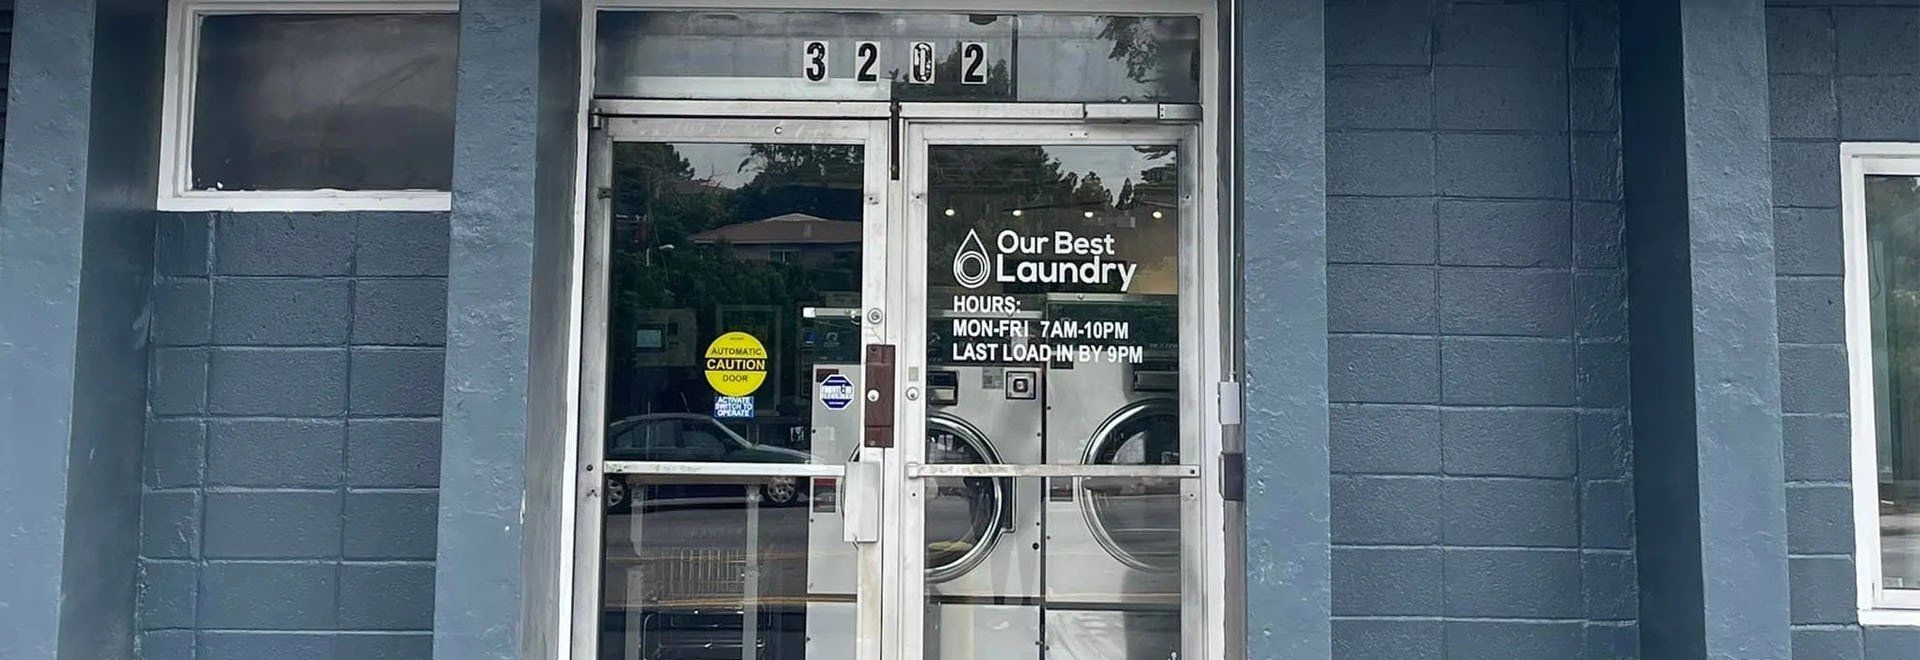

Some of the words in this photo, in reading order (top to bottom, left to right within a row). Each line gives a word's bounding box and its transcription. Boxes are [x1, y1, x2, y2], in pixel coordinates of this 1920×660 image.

[997, 230, 1049, 254] Our
[1054, 231, 1115, 255] Best
[996, 254, 1137, 292] Laundry
[953, 295, 1021, 313] HOURS:
[953, 319, 1029, 337] MON-FRI
[1040, 321, 1129, 339] 7AM-10PM
[711, 347, 762, 356] AUTOMATIC
[952, 343, 998, 361] LAST
[1003, 344, 1050, 362] LOAD
[1056, 345, 1074, 362] IN
[1078, 345, 1104, 363] BY
[1107, 346, 1143, 364] 9PM
[706, 359, 765, 370] CAUTION
[722, 374, 748, 382] DOOR
